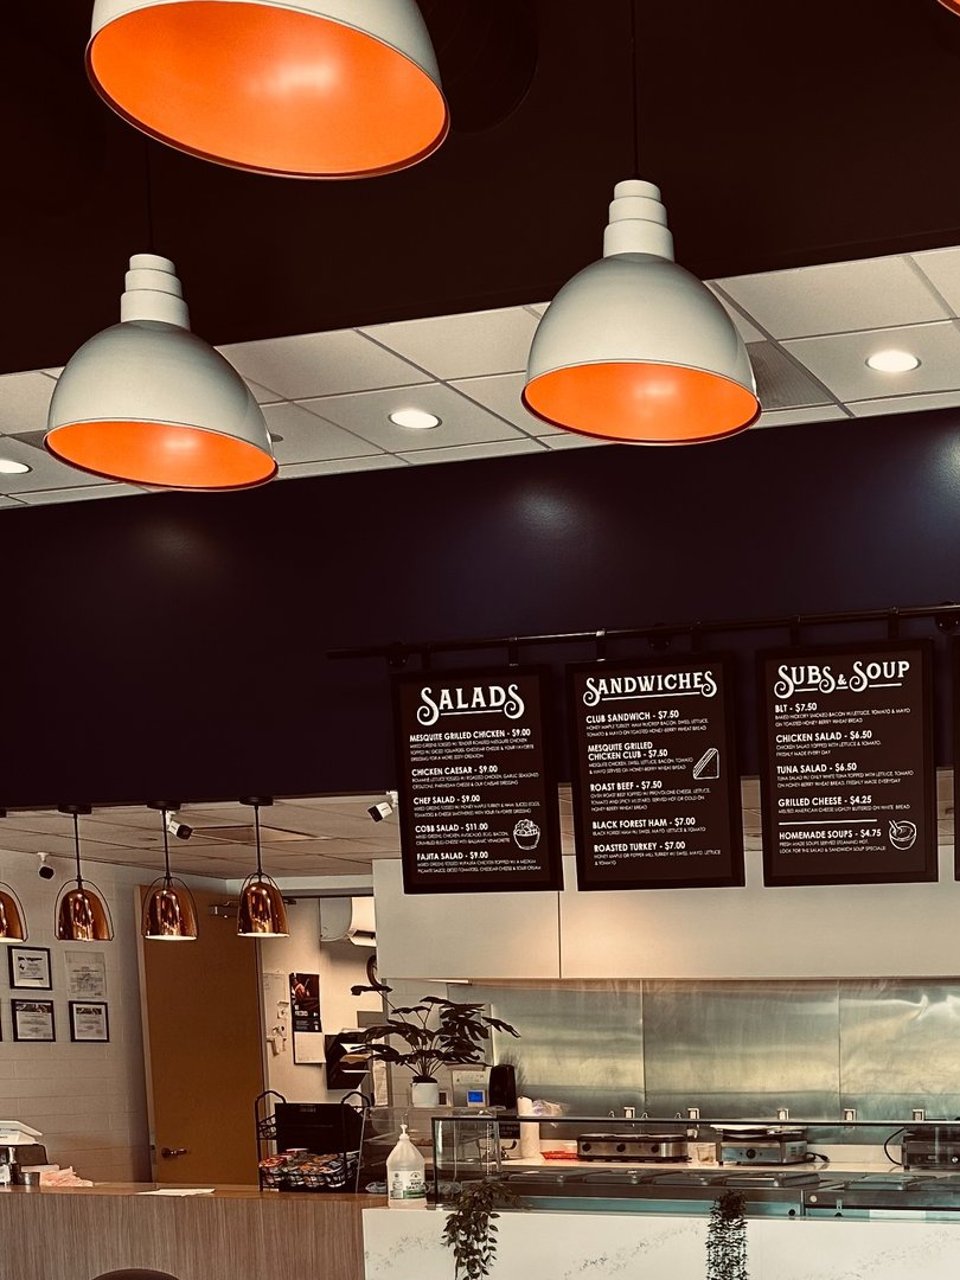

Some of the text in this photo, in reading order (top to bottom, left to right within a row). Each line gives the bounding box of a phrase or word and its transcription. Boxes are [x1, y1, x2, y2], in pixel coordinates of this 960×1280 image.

[774, 661, 909, 698] SUBS & SOUP
[583, 671, 717, 706] SANDWICHES
[417, 684, 524, 726] SALADS
[774, 703, 818, 712] BLT $7.50
[586, 710, 679, 724] CLUB SANDWICH $7.50
[409, 729, 531, 742] MESQUITE GRILLED CHICKEN $9.00
[776, 731, 872, 743] CHICKEN SALAD $6.50
[587, 742, 653, 752] MESQUITE GRILLED
[588, 749, 668, 761] CHICKEN CLUB $7.50
[411, 768, 443, 776] CHICKEN
[443, 766, 472, 775] CAESAR
[776, 763, 857, 774] TUNA SALAD $6.50
[590, 781, 662, 791] ROAST BEEF $7.50
[431, 796, 455, 804] SALAD
[460, 795, 481, 803] $9.00
[778, 796, 872, 807] GRILLED CHEESE $4.25
[436, 824, 459, 832] SALAD
[465, 823, 488, 831] $11.00
[592, 818, 696, 829] BLACK FOREST HAM $7.00
[779, 829, 882, 840] HOMEMADE SOUPS $4.75
[593, 842, 686, 852] ROASTED TURKEY $7.00
[440, 852, 464, 860] SALAD
[469, 851, 489, 859] $9.00
